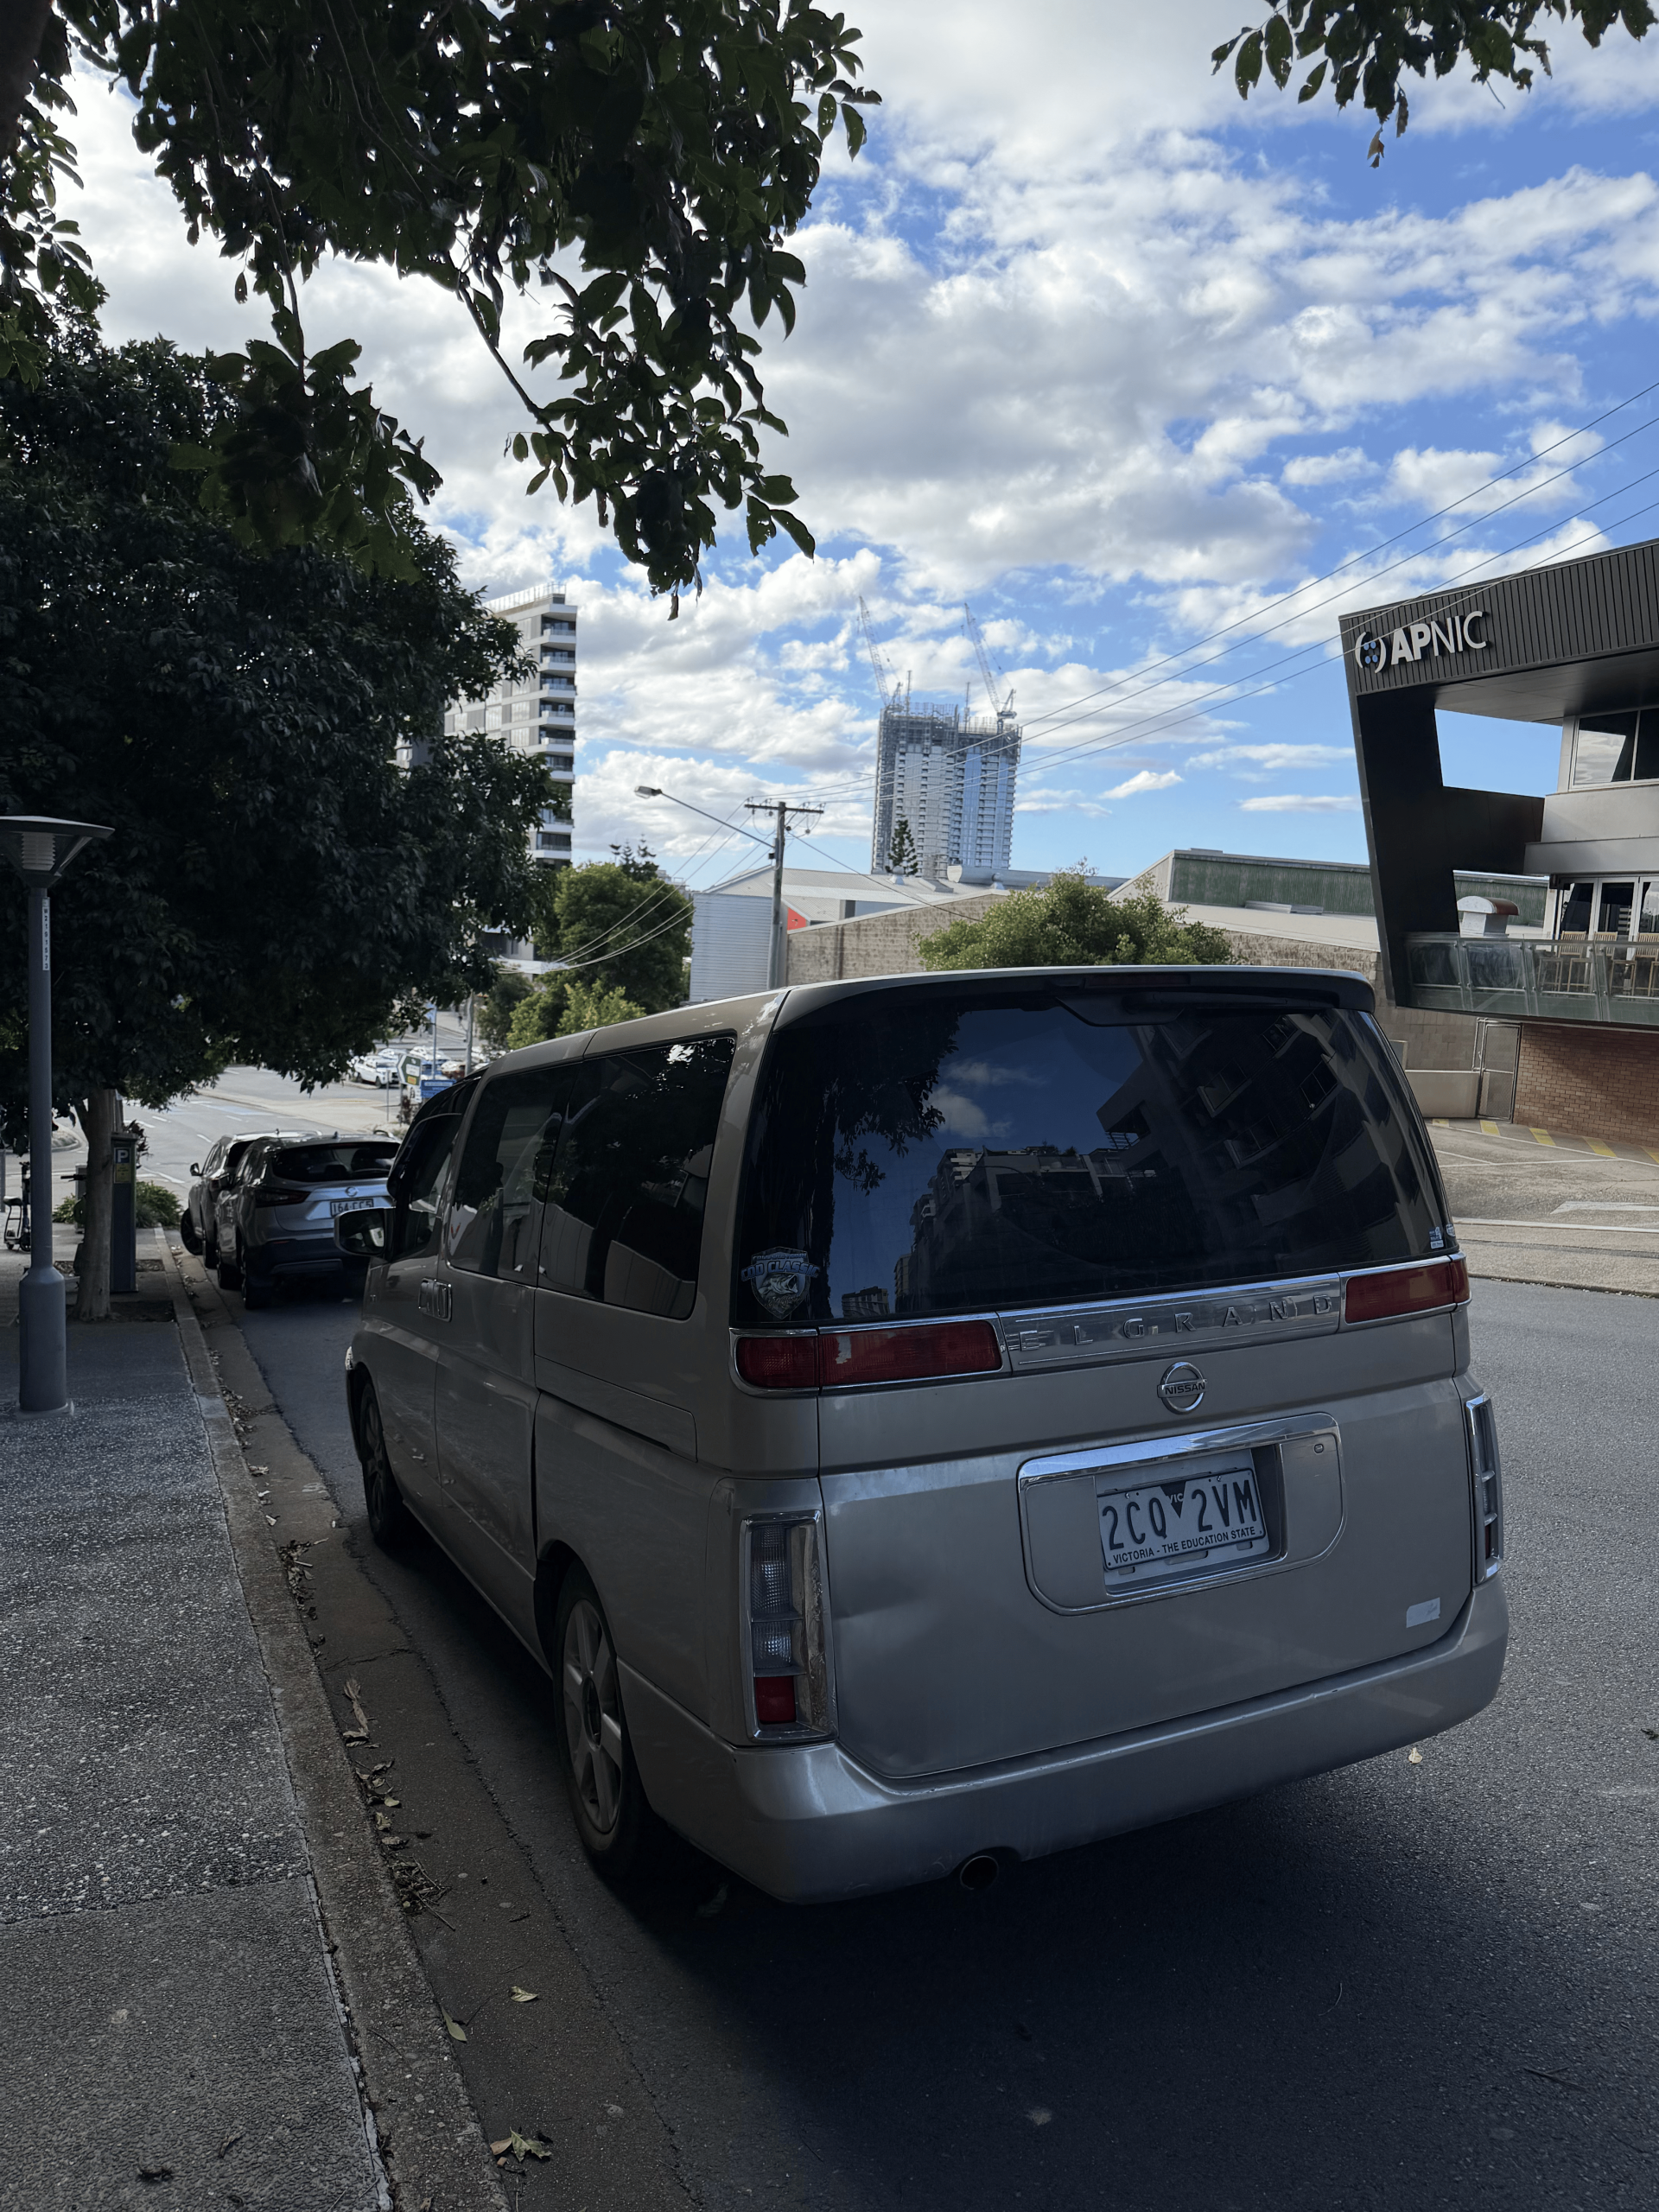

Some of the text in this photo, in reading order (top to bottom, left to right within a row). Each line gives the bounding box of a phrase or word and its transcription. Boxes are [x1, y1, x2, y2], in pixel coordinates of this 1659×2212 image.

[1391, 611, 1487, 665] APNIC
[118, 1150, 128, 1162] P
[741, 1261, 820, 1281] COD CLASSIC
[1018, 1294, 1332, 1352] ELGRAND
[1165, 1382, 1205, 1395] NISSAN
[1168, 1492, 1185, 1504] VIC
[1102, 1479, 1257, 1551] 2CQ 2VM
[1113, 1548, 1155, 1565] VICTORIA
[1161, 1541, 1179, 1554] THE
[1181, 1532, 1229, 1550] EDUCATION
[1230, 1526, 1256, 1540] STATE
